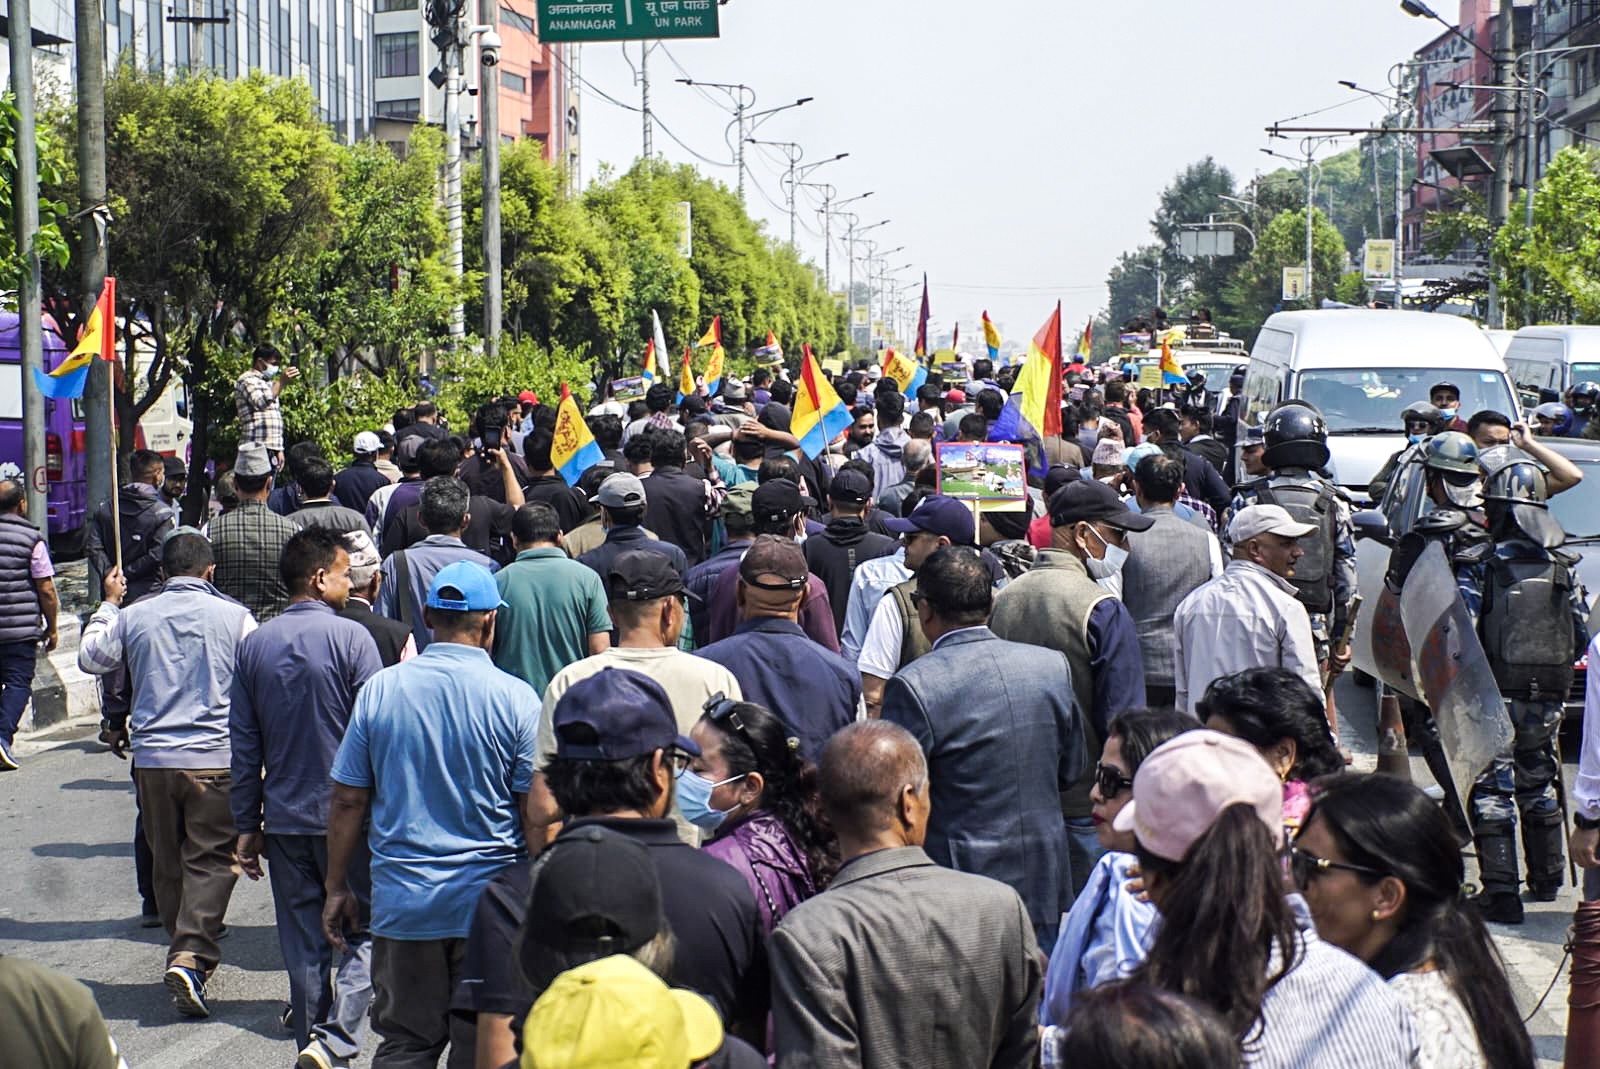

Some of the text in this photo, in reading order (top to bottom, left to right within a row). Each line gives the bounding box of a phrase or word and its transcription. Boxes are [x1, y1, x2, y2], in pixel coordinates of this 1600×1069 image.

[548, 3, 613, 15] अनामनगर
[645, 2, 659, 17] यू
[549, 19, 617, 31] ANAMNAGAR
[655, 16, 703, 28] UN PARK
